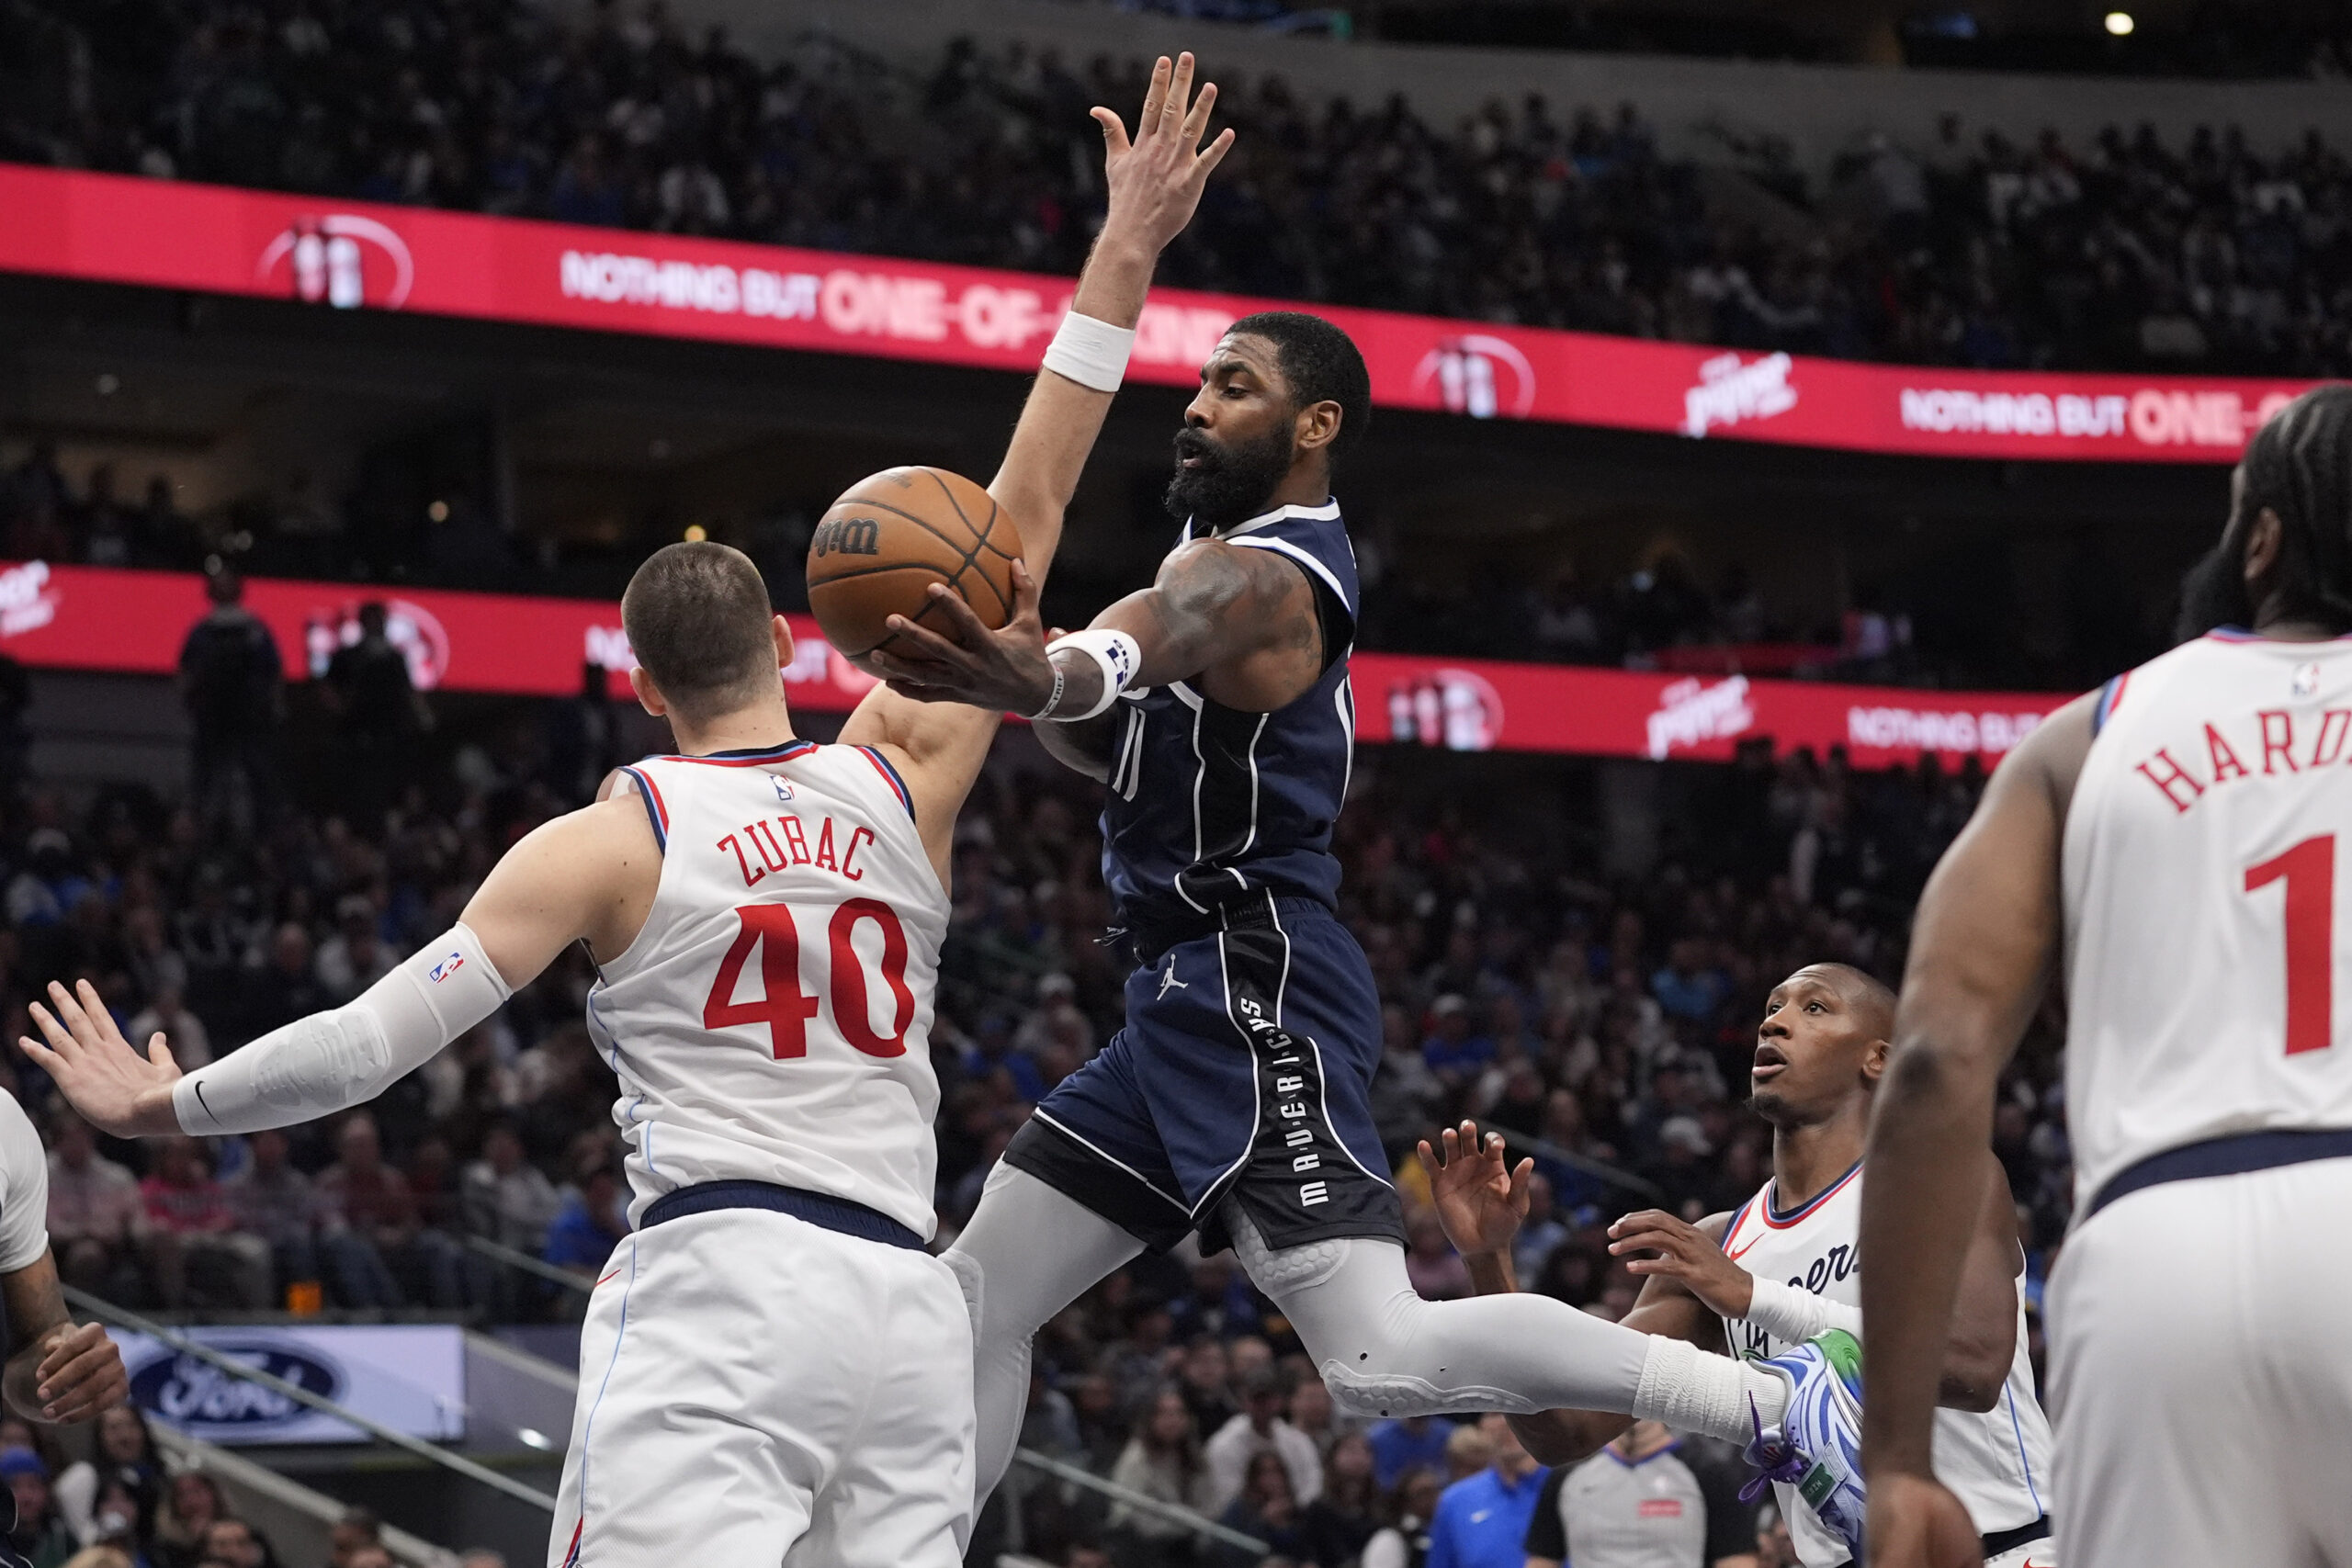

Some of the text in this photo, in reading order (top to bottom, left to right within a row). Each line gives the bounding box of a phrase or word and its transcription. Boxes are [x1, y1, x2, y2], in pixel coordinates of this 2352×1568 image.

[560, 250, 738, 313] NOTHING
[741, 267, 820, 321] BUT
[1900, 388, 2055, 435] NOTHING
[2057, 394, 2128, 436] BUT
[1848, 705, 1976, 751] NOTHING
[2133, 709, 2352, 815] HARD
[717, 816, 876, 887] ZUBAC
[703, 897, 915, 1059] 40
[2245, 832, 2335, 1057] 1
[1240, 998, 1329, 1207] MAVERICKS
